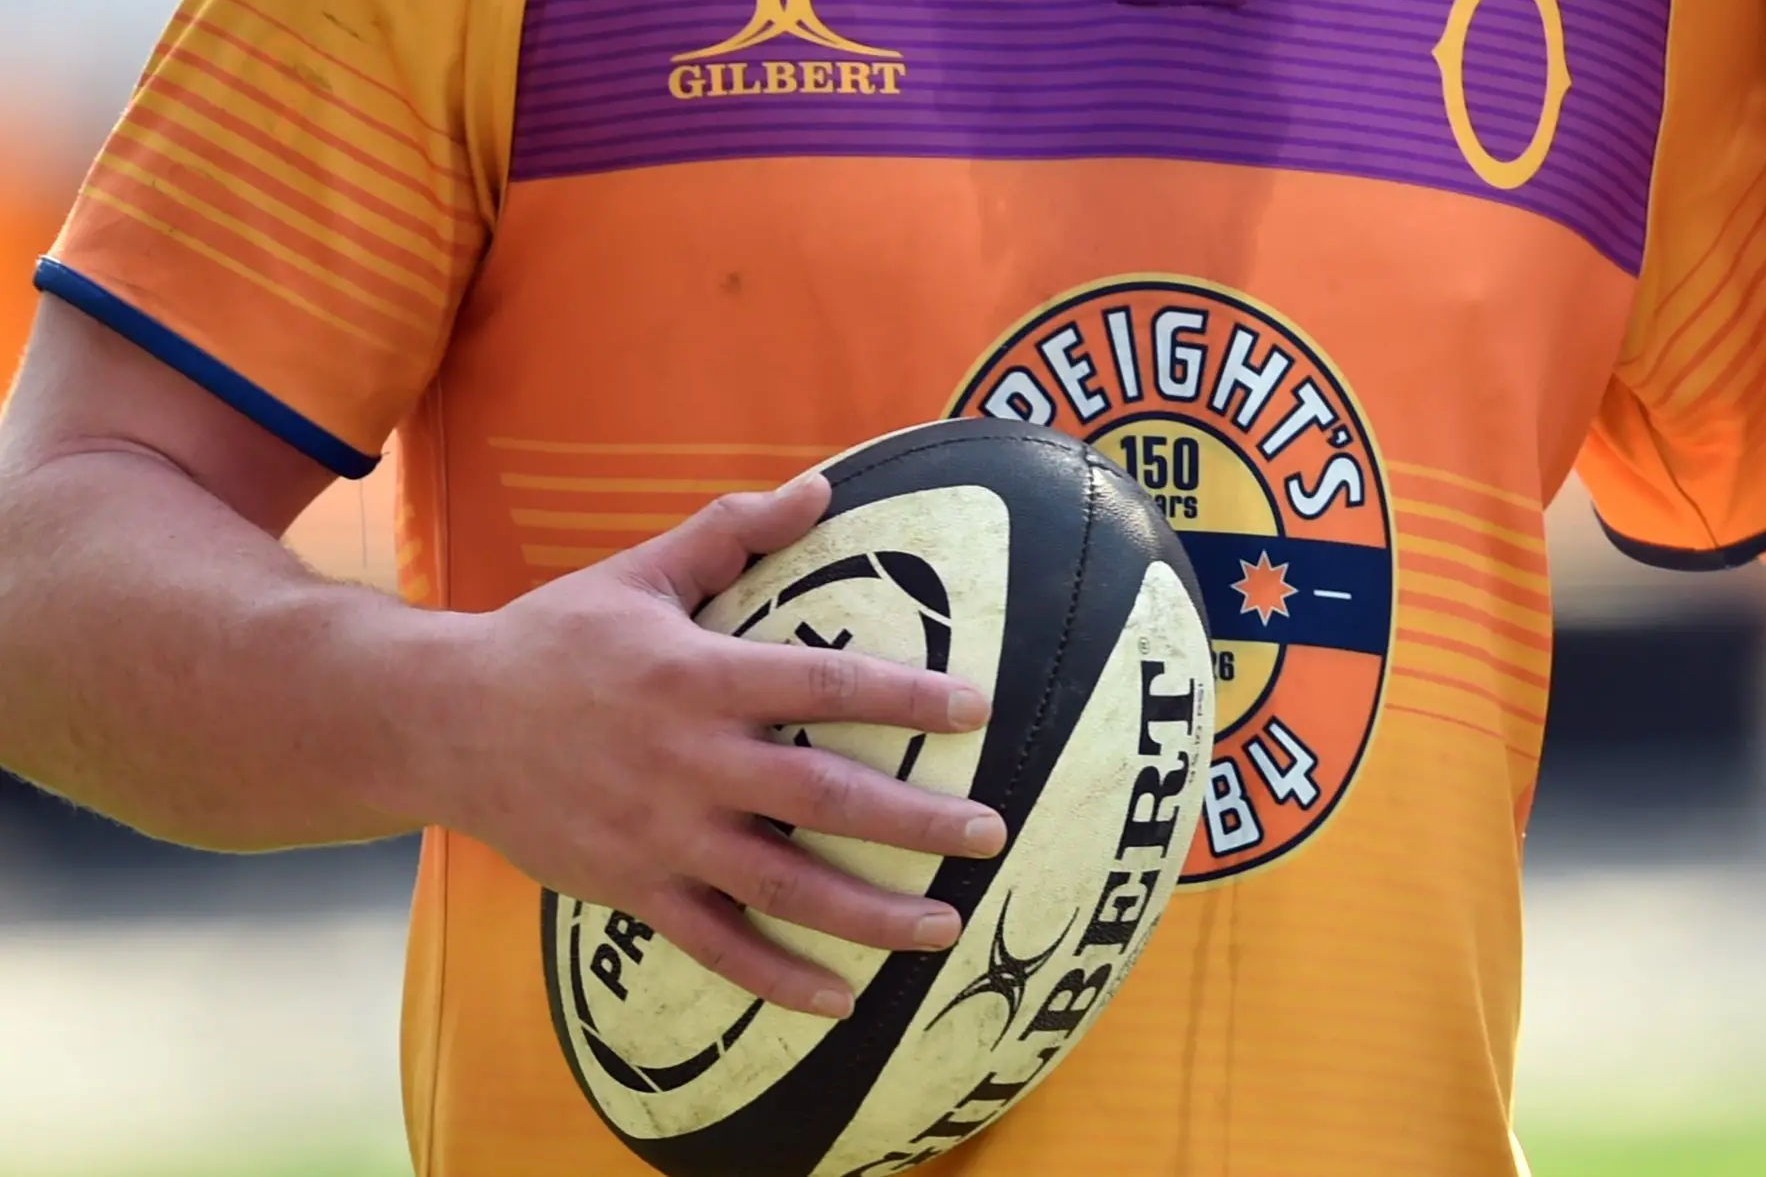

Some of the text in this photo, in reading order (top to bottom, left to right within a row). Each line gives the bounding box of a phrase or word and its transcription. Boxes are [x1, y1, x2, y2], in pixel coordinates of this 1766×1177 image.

[668, 62, 906, 100] GILBERT
[981, 305, 1365, 519] PEIGHT'S
[1120, 435, 1200, 492] 150
